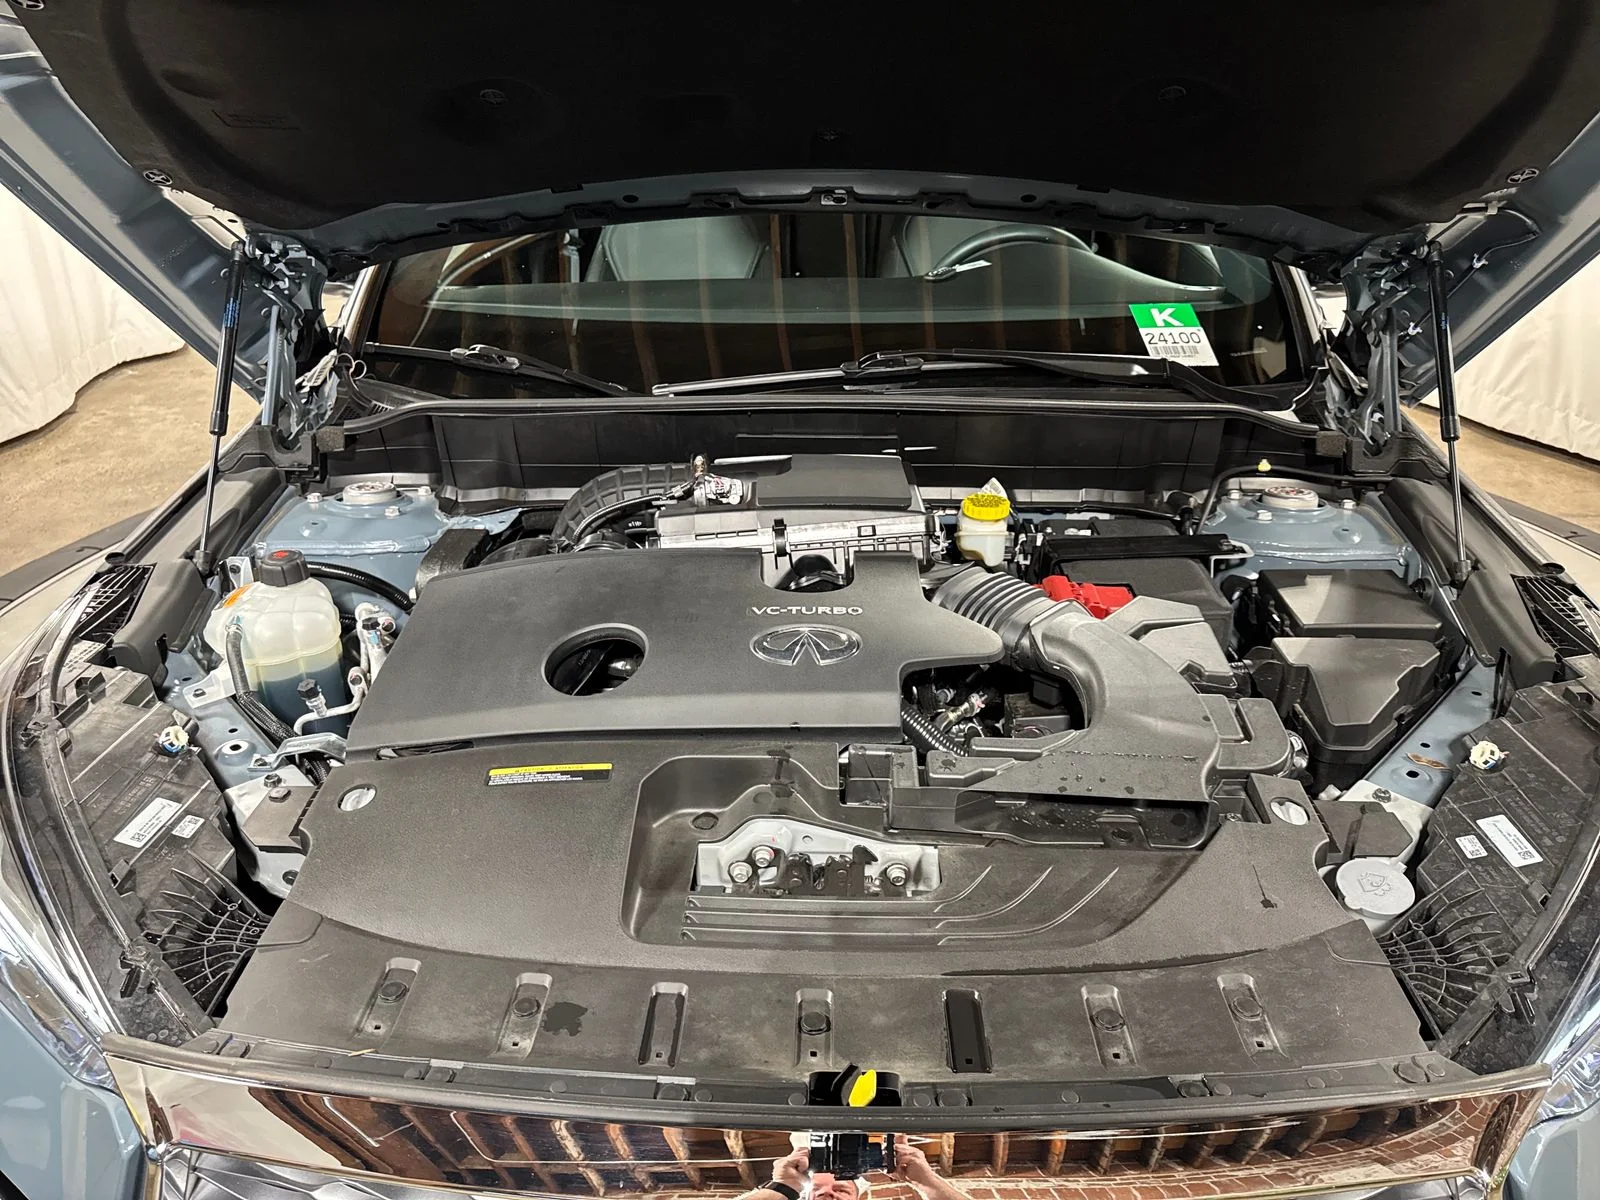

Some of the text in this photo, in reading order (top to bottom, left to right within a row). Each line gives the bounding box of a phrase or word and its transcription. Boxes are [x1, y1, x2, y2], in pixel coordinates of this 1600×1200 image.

[1150, 307, 1184, 327] K
[1145, 332, 1201, 345] 24100
[752, 606, 863, 615] VC-TURBO
